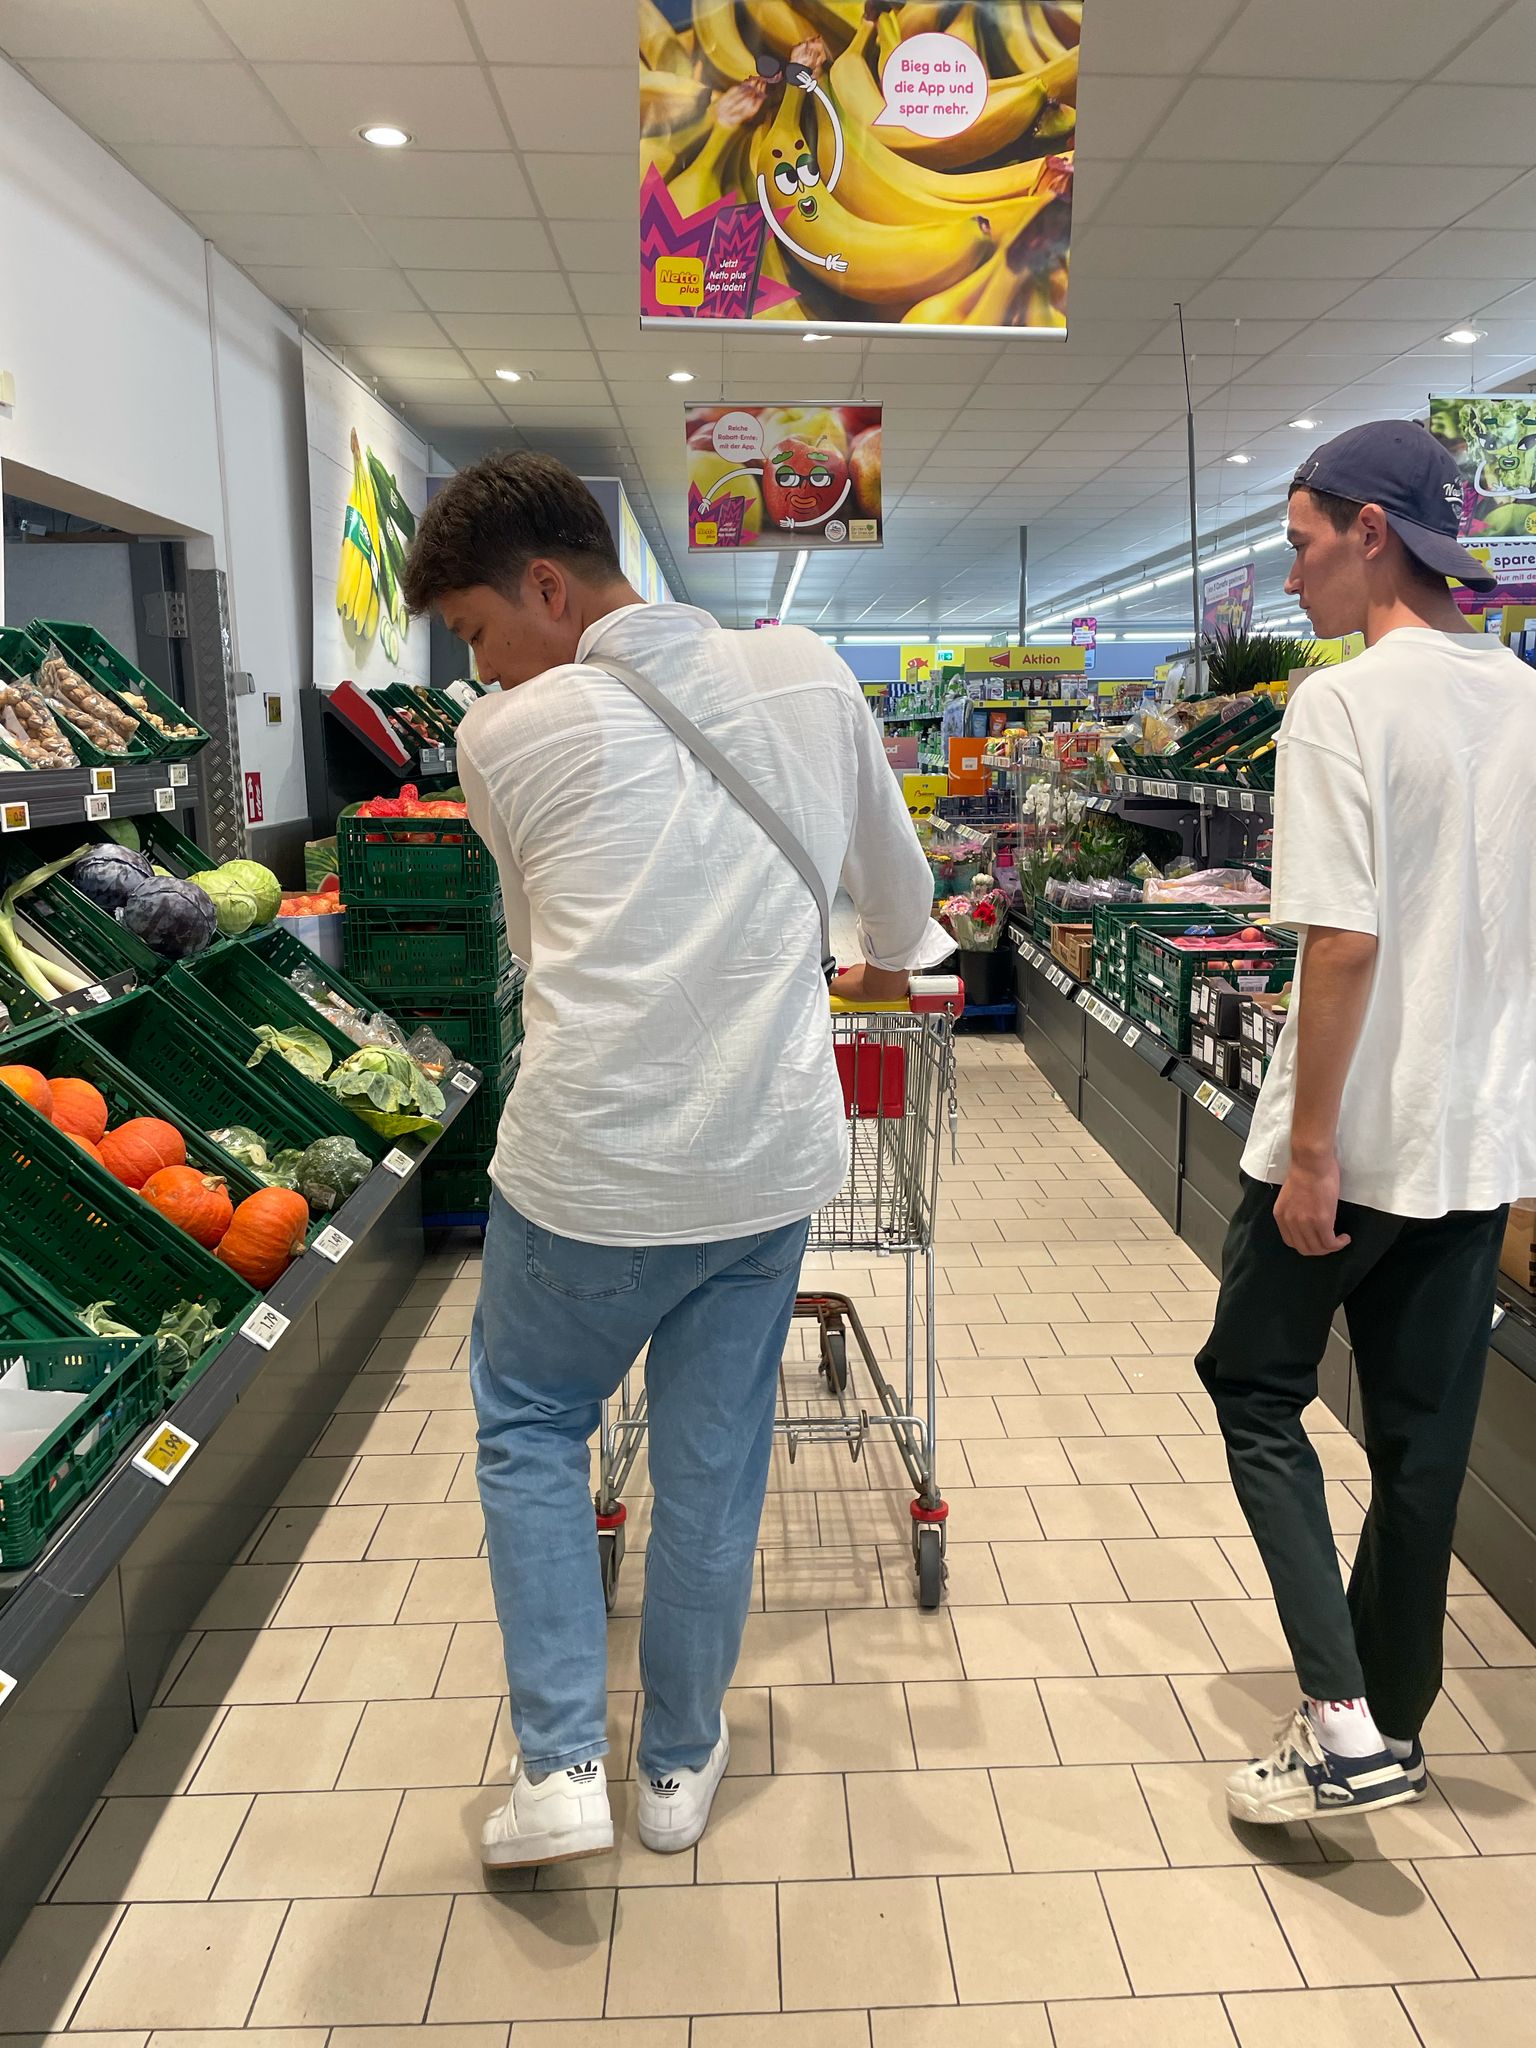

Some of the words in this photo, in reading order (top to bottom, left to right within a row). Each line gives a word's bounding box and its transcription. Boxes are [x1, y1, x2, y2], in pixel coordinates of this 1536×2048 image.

[901, 59, 930, 75] Bieg
[933, 60, 951, 73] ab
[955, 60, 967, 73] in
[894, 80, 914, 93] die
[918, 80, 945, 97] App
[949, 81, 974, 94] und
[899, 103, 929, 117] spar
[933, 102, 969, 115] mehr.
[719, 259, 739, 269] Jetzt
[660, 269, 700, 285] Netto
[709, 270, 729, 280] Netto
[730, 271, 747, 282] plus
[680, 285, 700, 295] plus
[705, 282, 721, 293] App
[721, 282, 747, 292] laden!
[1512, 573, 1525, 581] mit
[1022, 653, 1061, 665] Aktion
[260, 1312, 278, 1330] 1.79
[158, 1433, 184, 1457] 1.99
